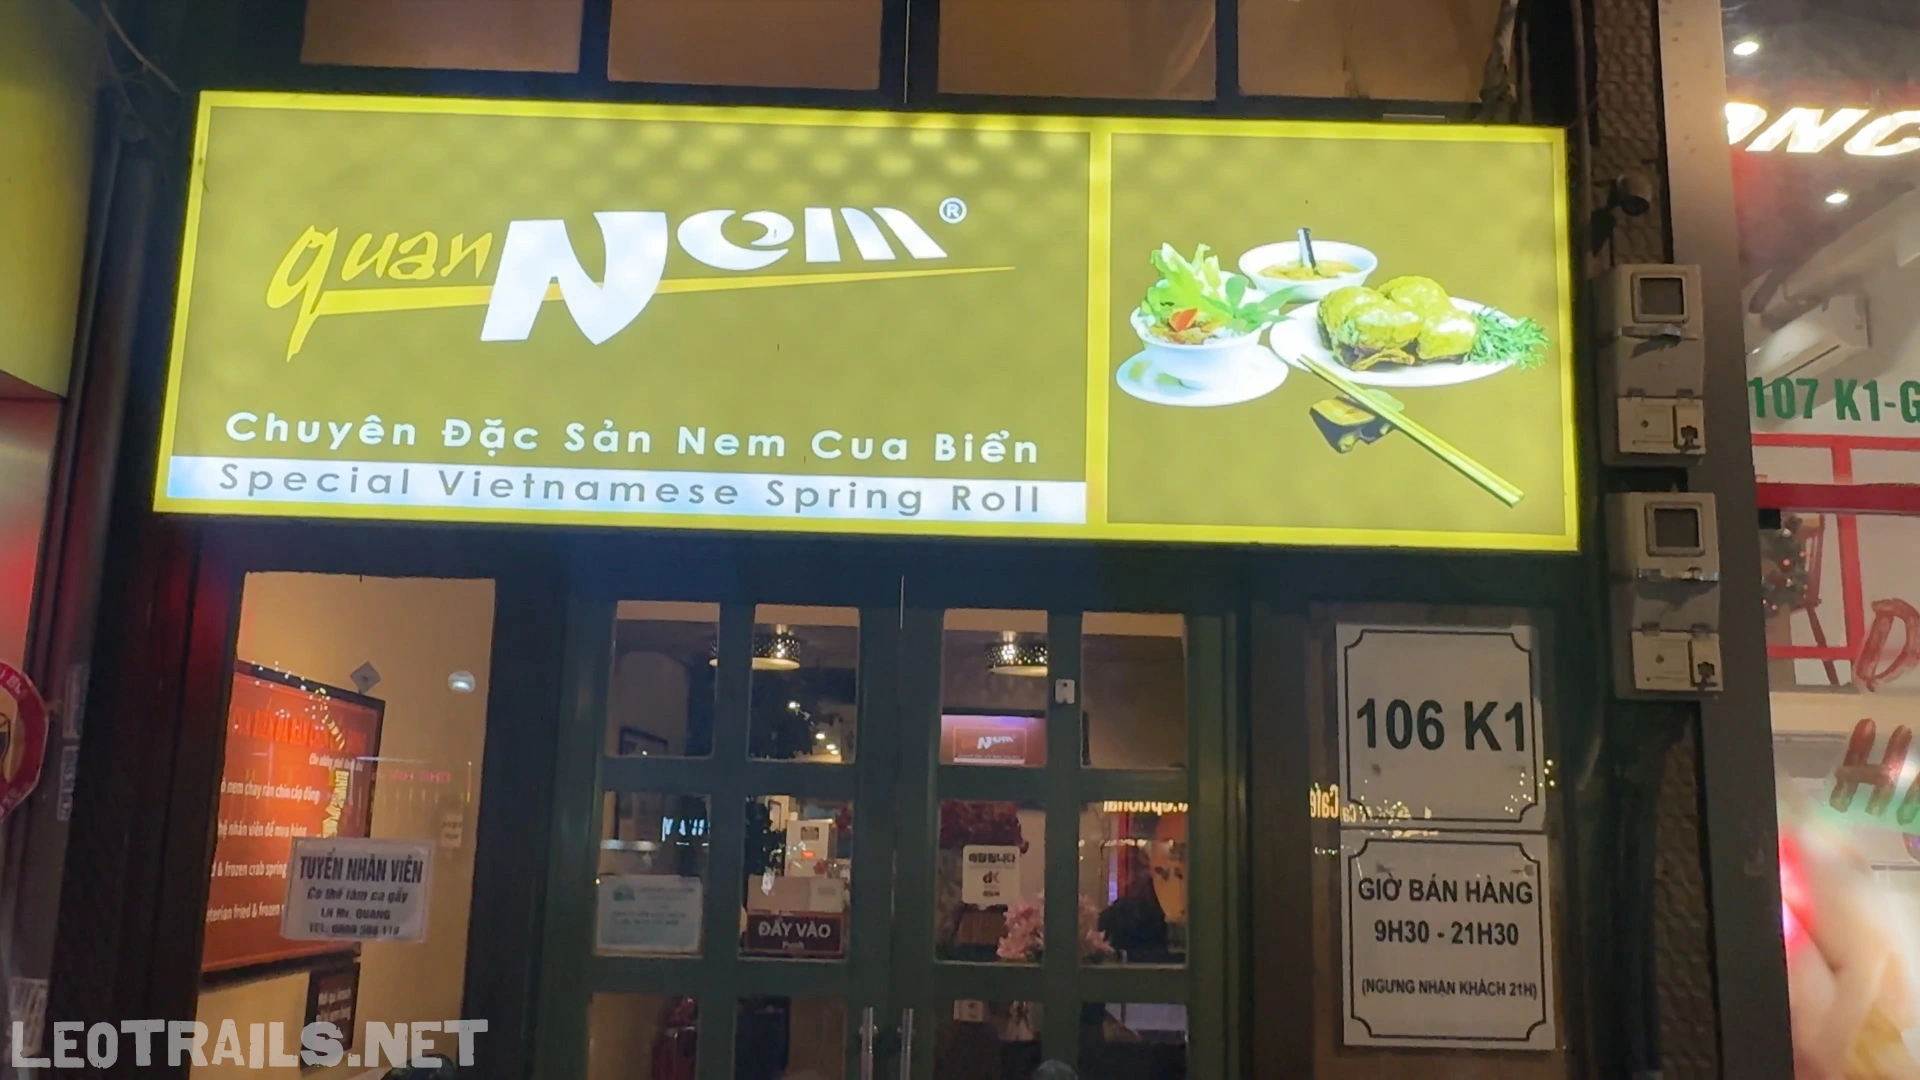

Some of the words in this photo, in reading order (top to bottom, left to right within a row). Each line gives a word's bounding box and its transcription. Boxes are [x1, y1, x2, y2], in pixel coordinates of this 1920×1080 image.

[266, 224, 493, 362] quan
[480, 206, 948, 346] Nem
[1748, 376, 1818, 419] 107
[225, 412, 416, 450] Chuyên
[442, 418, 539, 457] Đặc
[564, 419, 651, 453] Sản
[677, 426, 786, 457] Nem
[811, 430, 908, 461] Cua
[934, 429, 1037, 463] Biển
[219, 462, 410, 498] Special
[438, 469, 738, 505] Vietnamese
[766, 479, 922, 517] Spring
[952, 485, 1038, 513] Roll
[1357, 697, 1446, 751] 106
[1464, 700, 1525, 751] K1
[1829, 717, 1920, 826] H
[225, 860, 248, 877] frozen
[248, 860, 265, 876] crab
[299, 848, 344, 880] TUYỂN
[346, 852, 388, 882] NHÂN
[391, 853, 423, 883] VIÊN
[1358, 872, 1402, 901] GIỜ
[1409, 873, 1458, 903] BÁN
[1465, 874, 1534, 905] HÀNG
[795, 920, 832, 938] VÀO
[1374, 919, 1431, 944] 9H30
[1451, 921, 1520, 946] 21H30
[1459, 978, 1507, 997] KHÁCH
[1509, 982, 1538, 1001] 21H)
